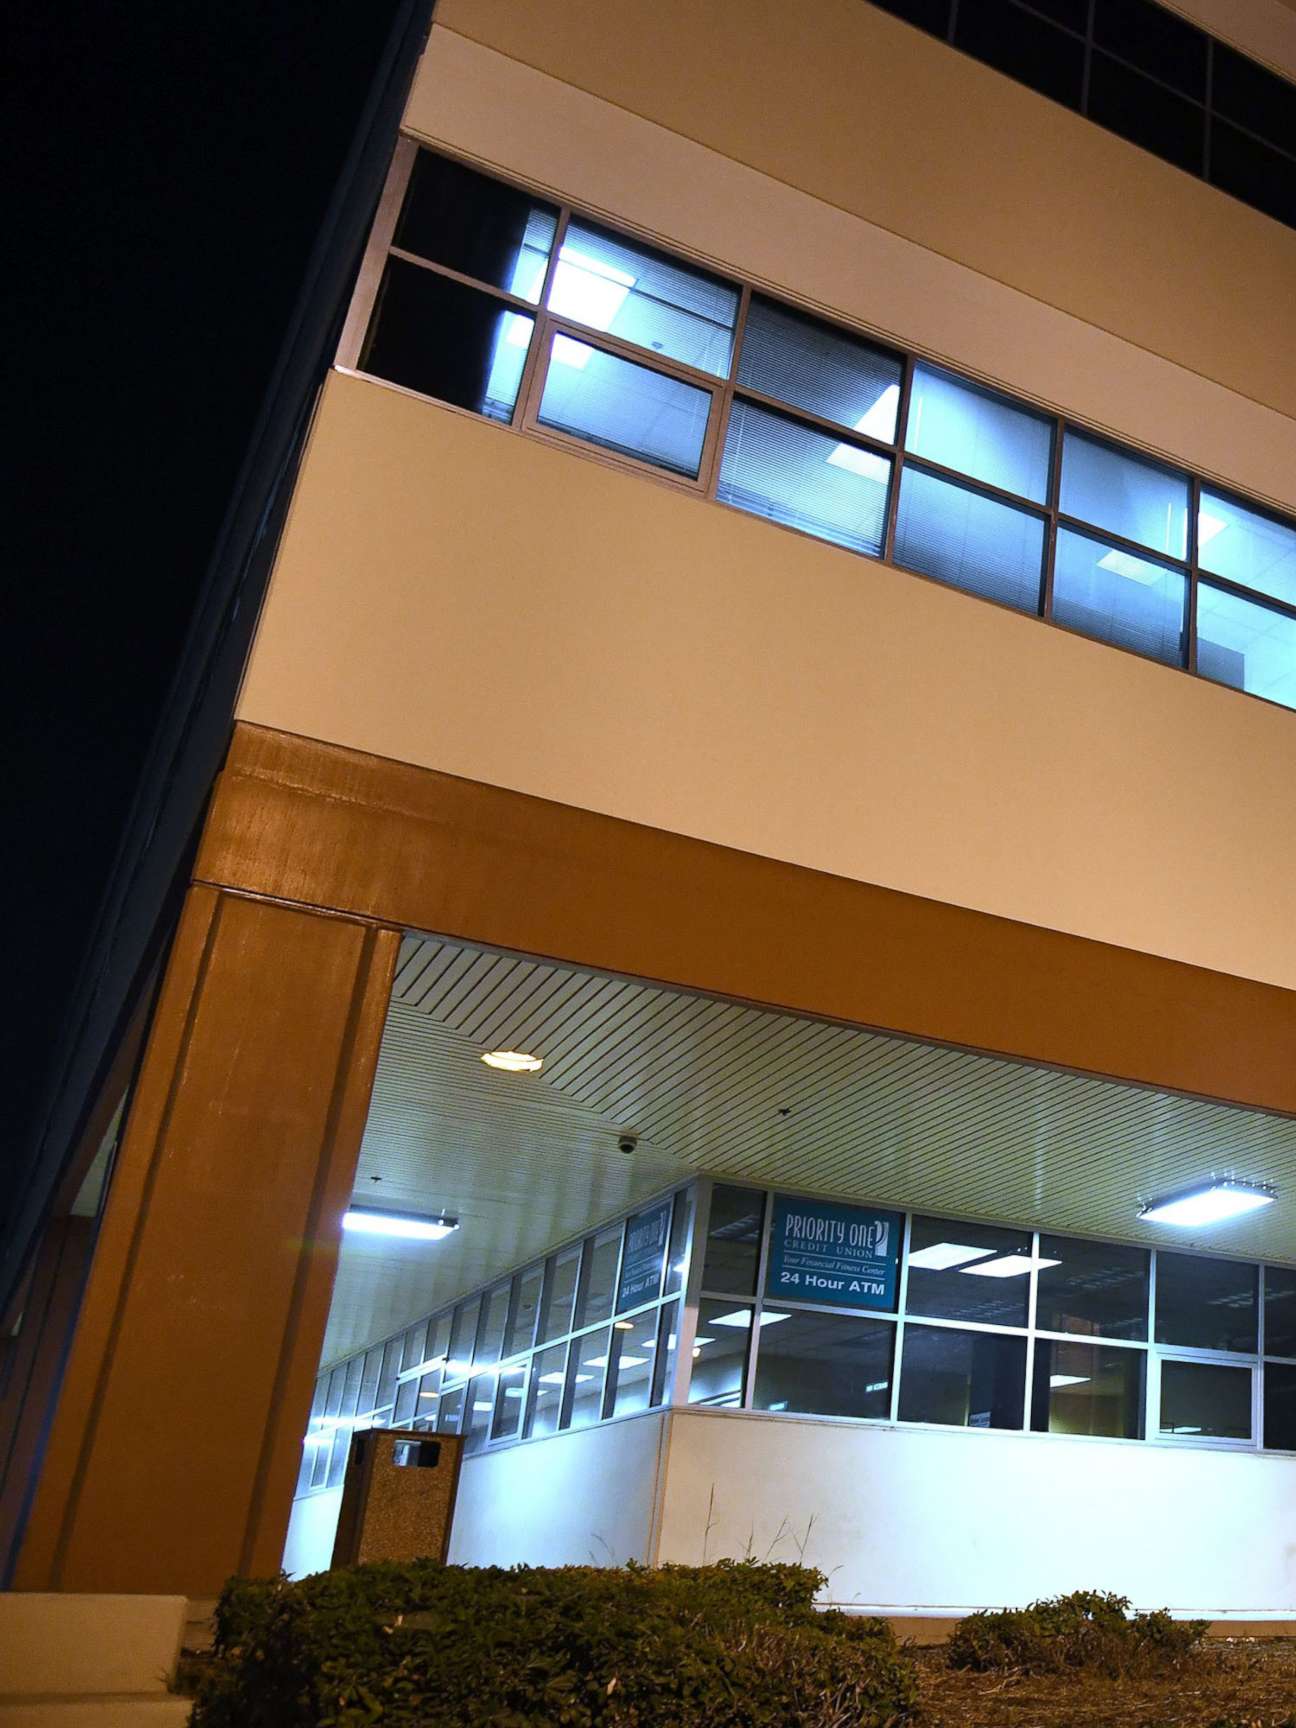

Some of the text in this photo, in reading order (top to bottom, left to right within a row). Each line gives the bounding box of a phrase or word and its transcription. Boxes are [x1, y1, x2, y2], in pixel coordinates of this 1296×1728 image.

[785, 1214, 875, 1249] PRIORITY ONE
[784, 1239, 874, 1259] CREDIT UNION
[801, 1257, 835, 1269] Financial
[780, 1271, 885, 1296] 24 Hour ATM
